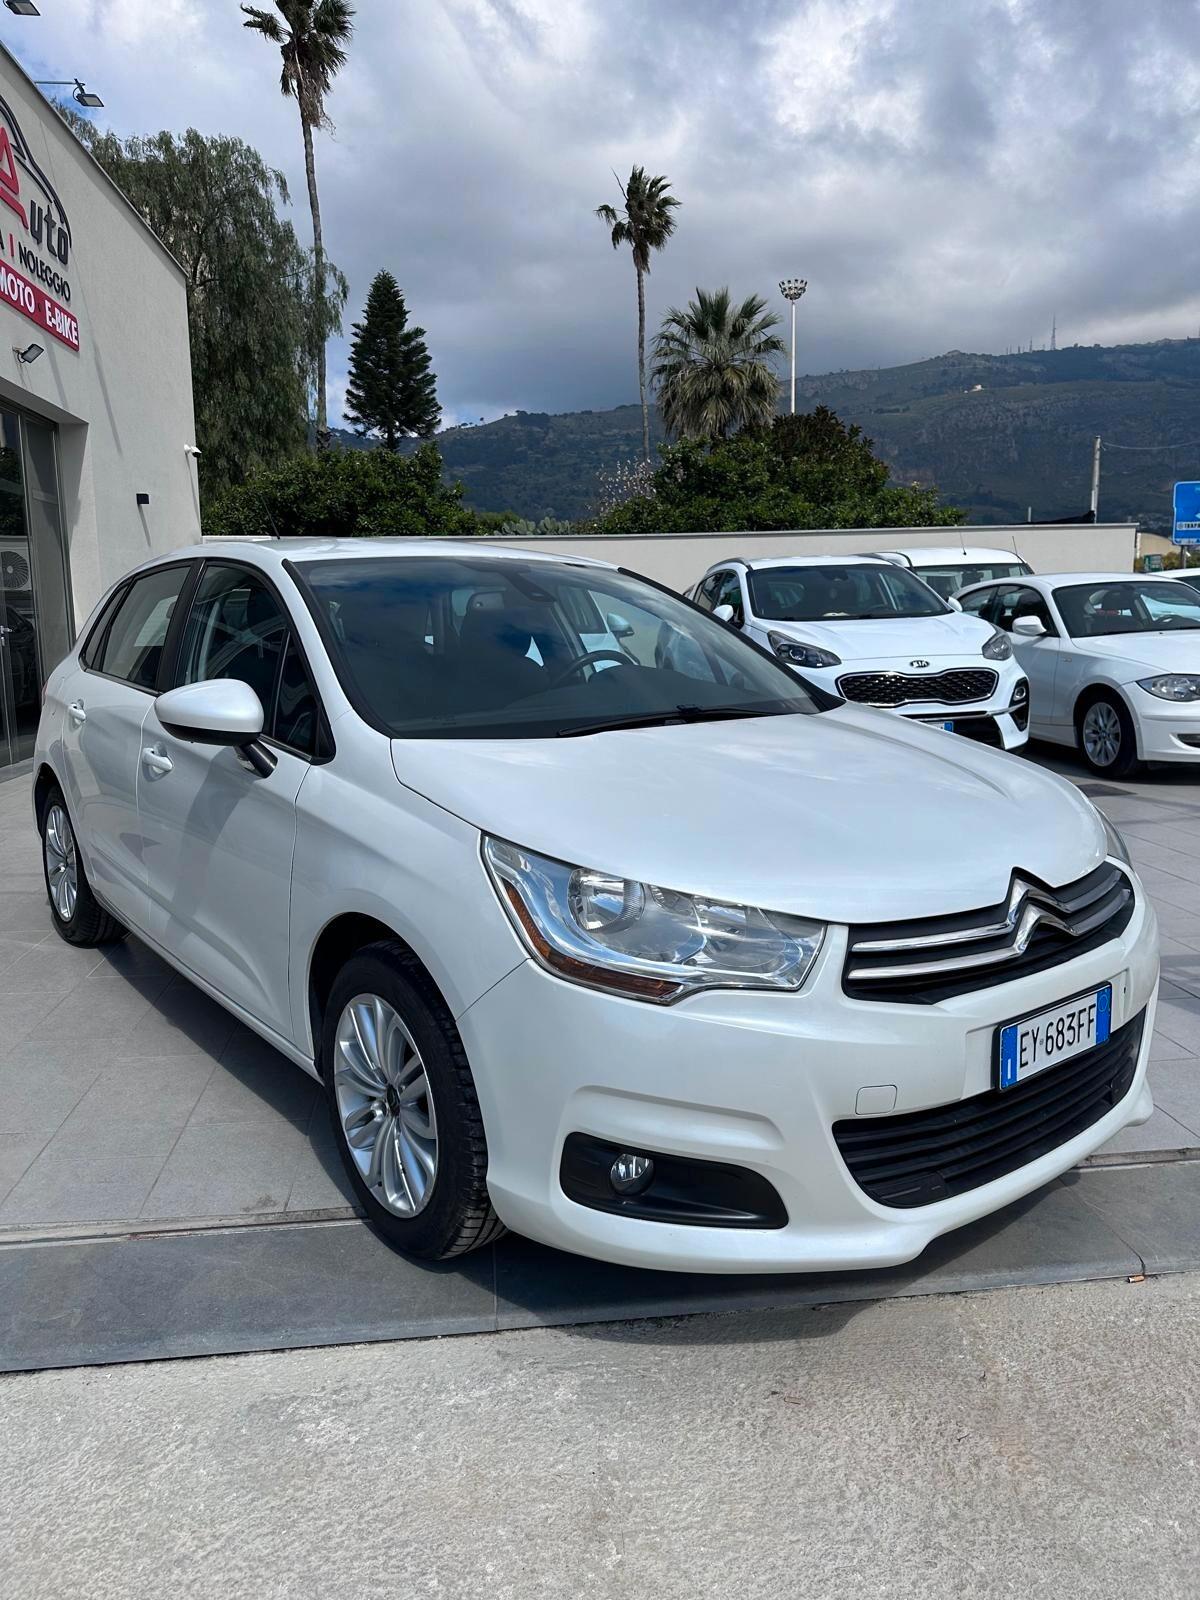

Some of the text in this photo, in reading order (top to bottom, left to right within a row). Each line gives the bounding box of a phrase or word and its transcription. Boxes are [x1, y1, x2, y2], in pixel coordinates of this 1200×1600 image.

[18, 241, 71, 301] NOLEGGIO
[0, 267, 79, 346] MOTO E-BIKE
